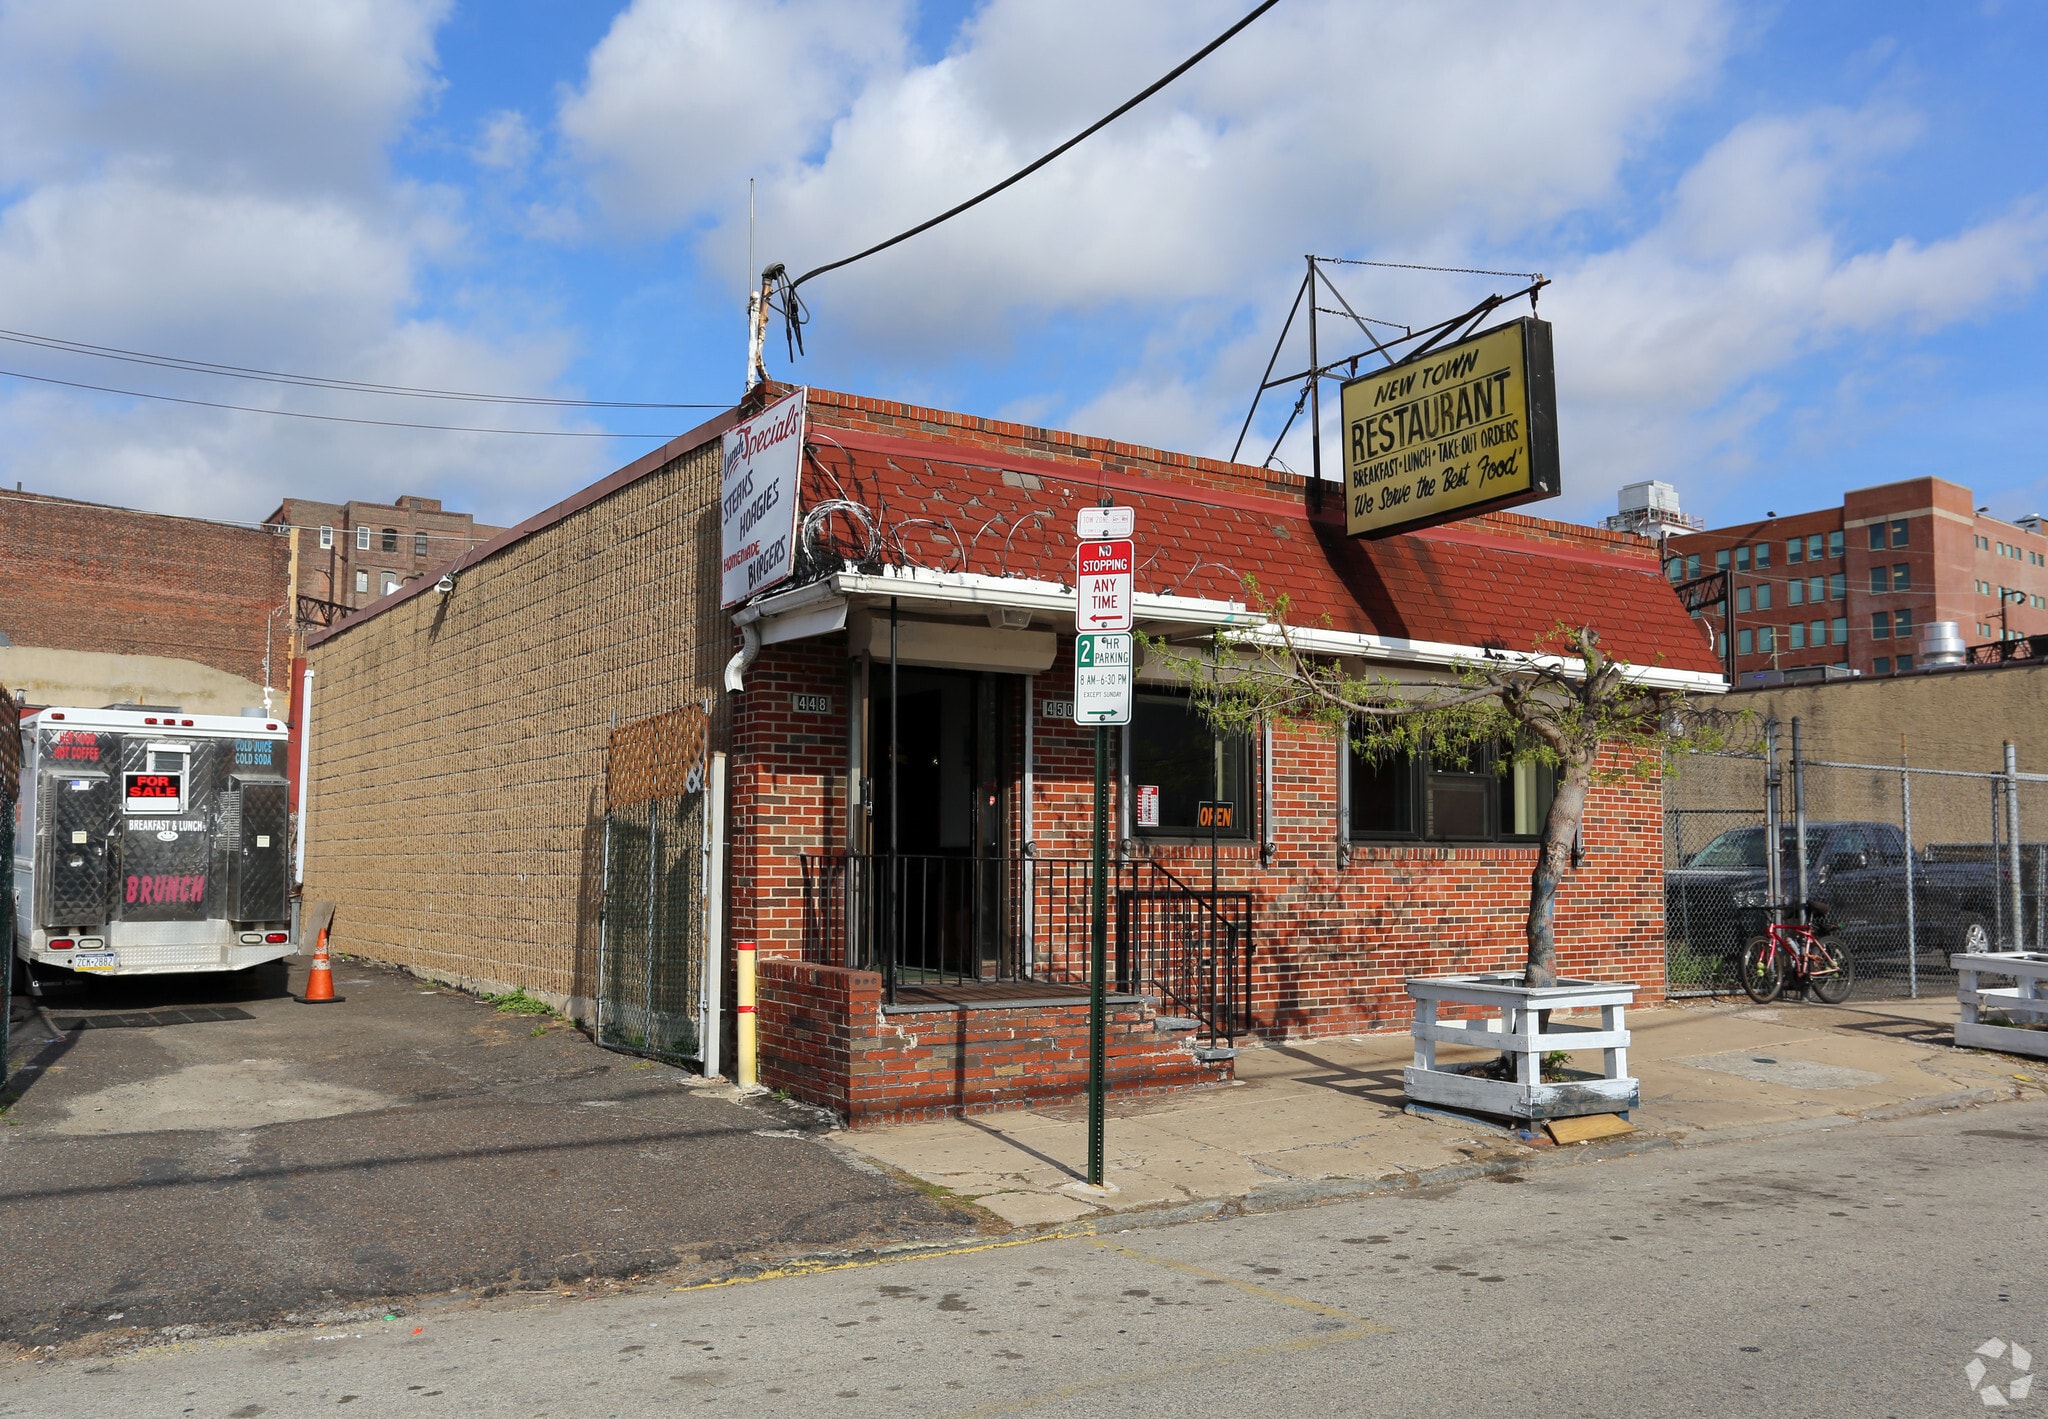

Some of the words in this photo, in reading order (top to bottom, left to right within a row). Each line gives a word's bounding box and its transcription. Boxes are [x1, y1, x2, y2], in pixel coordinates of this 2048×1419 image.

[1373, 371, 1416, 407] NEW
[1422, 349, 1479, 389] TOWN
[1352, 371, 1511, 463] RESTAURANT
[736, 404, 799, 466] Specials
[1353, 457, 1399, 488] BREAKFAST
[1403, 447, 1431, 473] LUNCH
[1480, 419, 1519, 449] ORDERS
[723, 468, 754, 525] STEAKS
[1354, 492, 1374, 518] We
[1378, 484, 1411, 510] Serve
[1416, 475, 1436, 499] the
[1442, 462, 1470, 493] Best
[740, 477, 780, 541] HOAGIES
[723, 540, 761, 573] HOMEMADE
[1098, 545, 1112, 557] NO
[747, 534, 786, 590] BURGERS
[1082, 558, 1128, 572] STOPPING
[1093, 578, 1117, 593] ANY
[1092, 594, 1118, 609] TIME
[1081, 640, 1091, 663] 2
[1106, 638, 1120, 650] HR
[1095, 652, 1128, 664] PARKING
[1080, 674, 1085, 686] 8
[1117, 673, 1127, 685] PM
[799, 696, 826, 711] 448
[1047, 702, 1073, 716] 450
[54, 746, 70, 759] HOT
[71, 746, 100, 760] COFFEE
[235, 739, 253, 752] COLD
[253, 740, 273, 753] JUICE
[235, 752, 253, 765] COLD
[253, 753, 272, 765] SODA
[137, 776, 169, 787] FOR
[129, 786, 177, 797] SALE
[128, 819, 170, 831] BREAKFAST
[171, 820, 178, 831] &
[179, 820, 203, 832] LUNCH
[126, 875, 205, 904] BRUNCH
